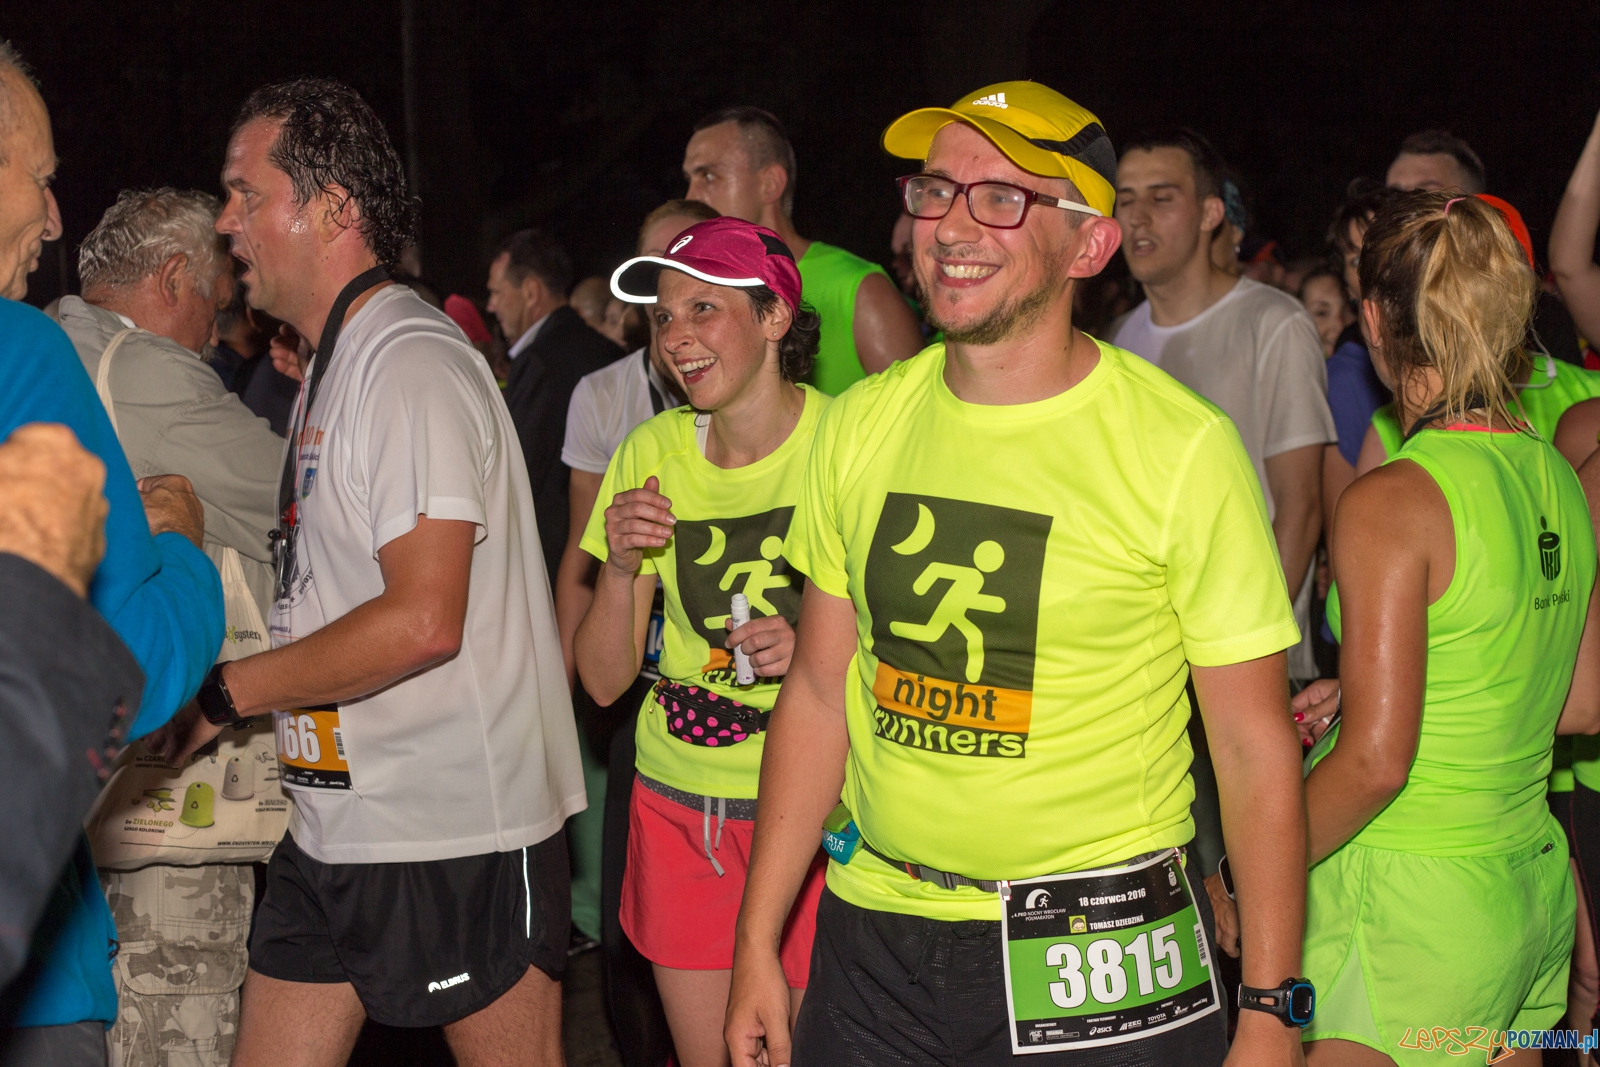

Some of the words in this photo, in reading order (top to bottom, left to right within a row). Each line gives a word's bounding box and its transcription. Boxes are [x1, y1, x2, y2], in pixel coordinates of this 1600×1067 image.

[972, 99, 1008, 110] adidas
[1534, 597, 1551, 610] Bank
[893, 675, 998, 722] night
[279, 714, 321, 764] 66
[874, 708, 1024, 757] runners
[132, 817, 174, 828] ZIELONEGO
[1078, 897, 1089, 907] 18
[1090, 893, 1127, 906] czerwca
[1127, 887, 1147, 901] 2016
[1089, 920, 1115, 930] TOMASZ
[1045, 922, 1184, 1009] 3815
[1147, 1013, 1167, 1022] TOYOTA
